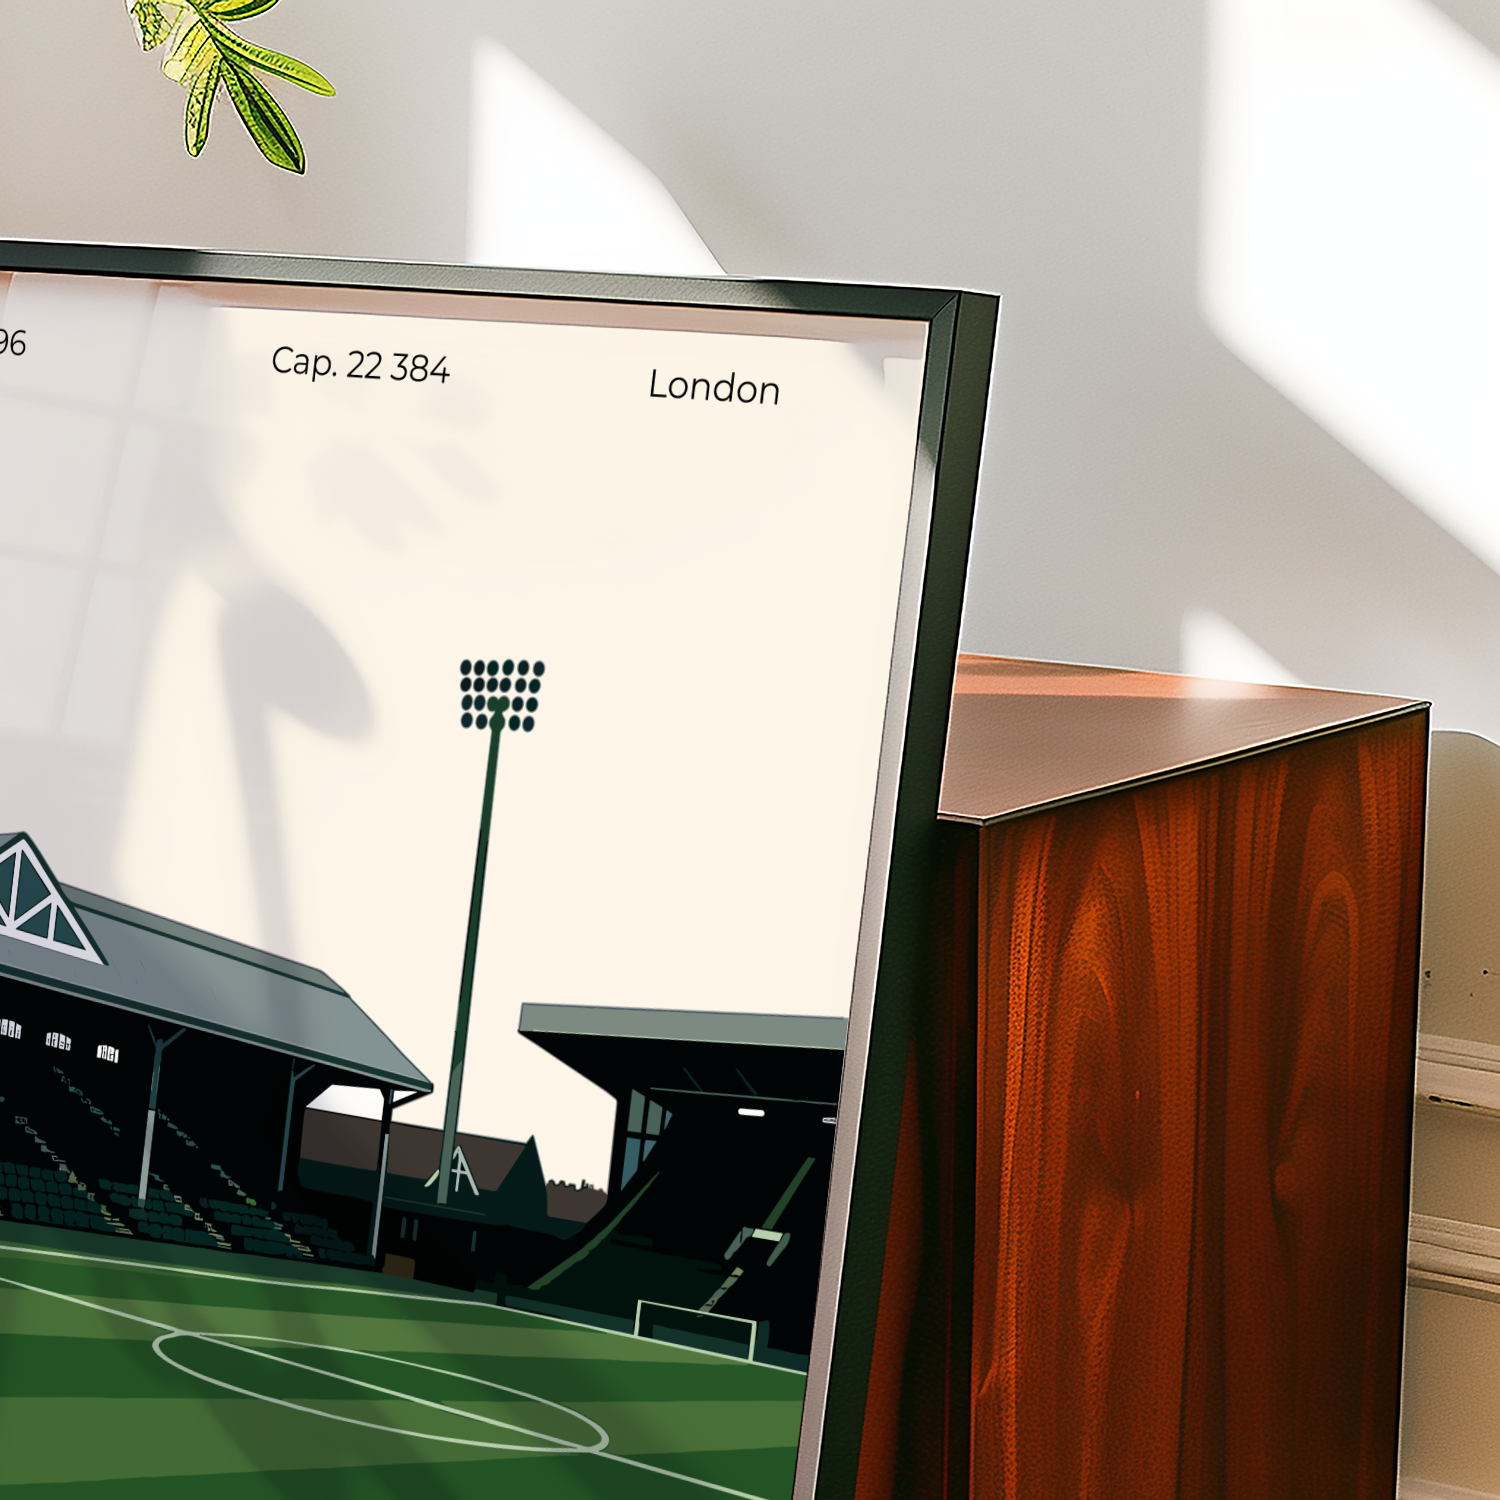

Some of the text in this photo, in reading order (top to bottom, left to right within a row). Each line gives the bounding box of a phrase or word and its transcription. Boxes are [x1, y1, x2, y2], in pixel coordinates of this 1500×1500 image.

[272, 346, 450, 383] Cap. 22 384
[650, 369, 779, 405] London
